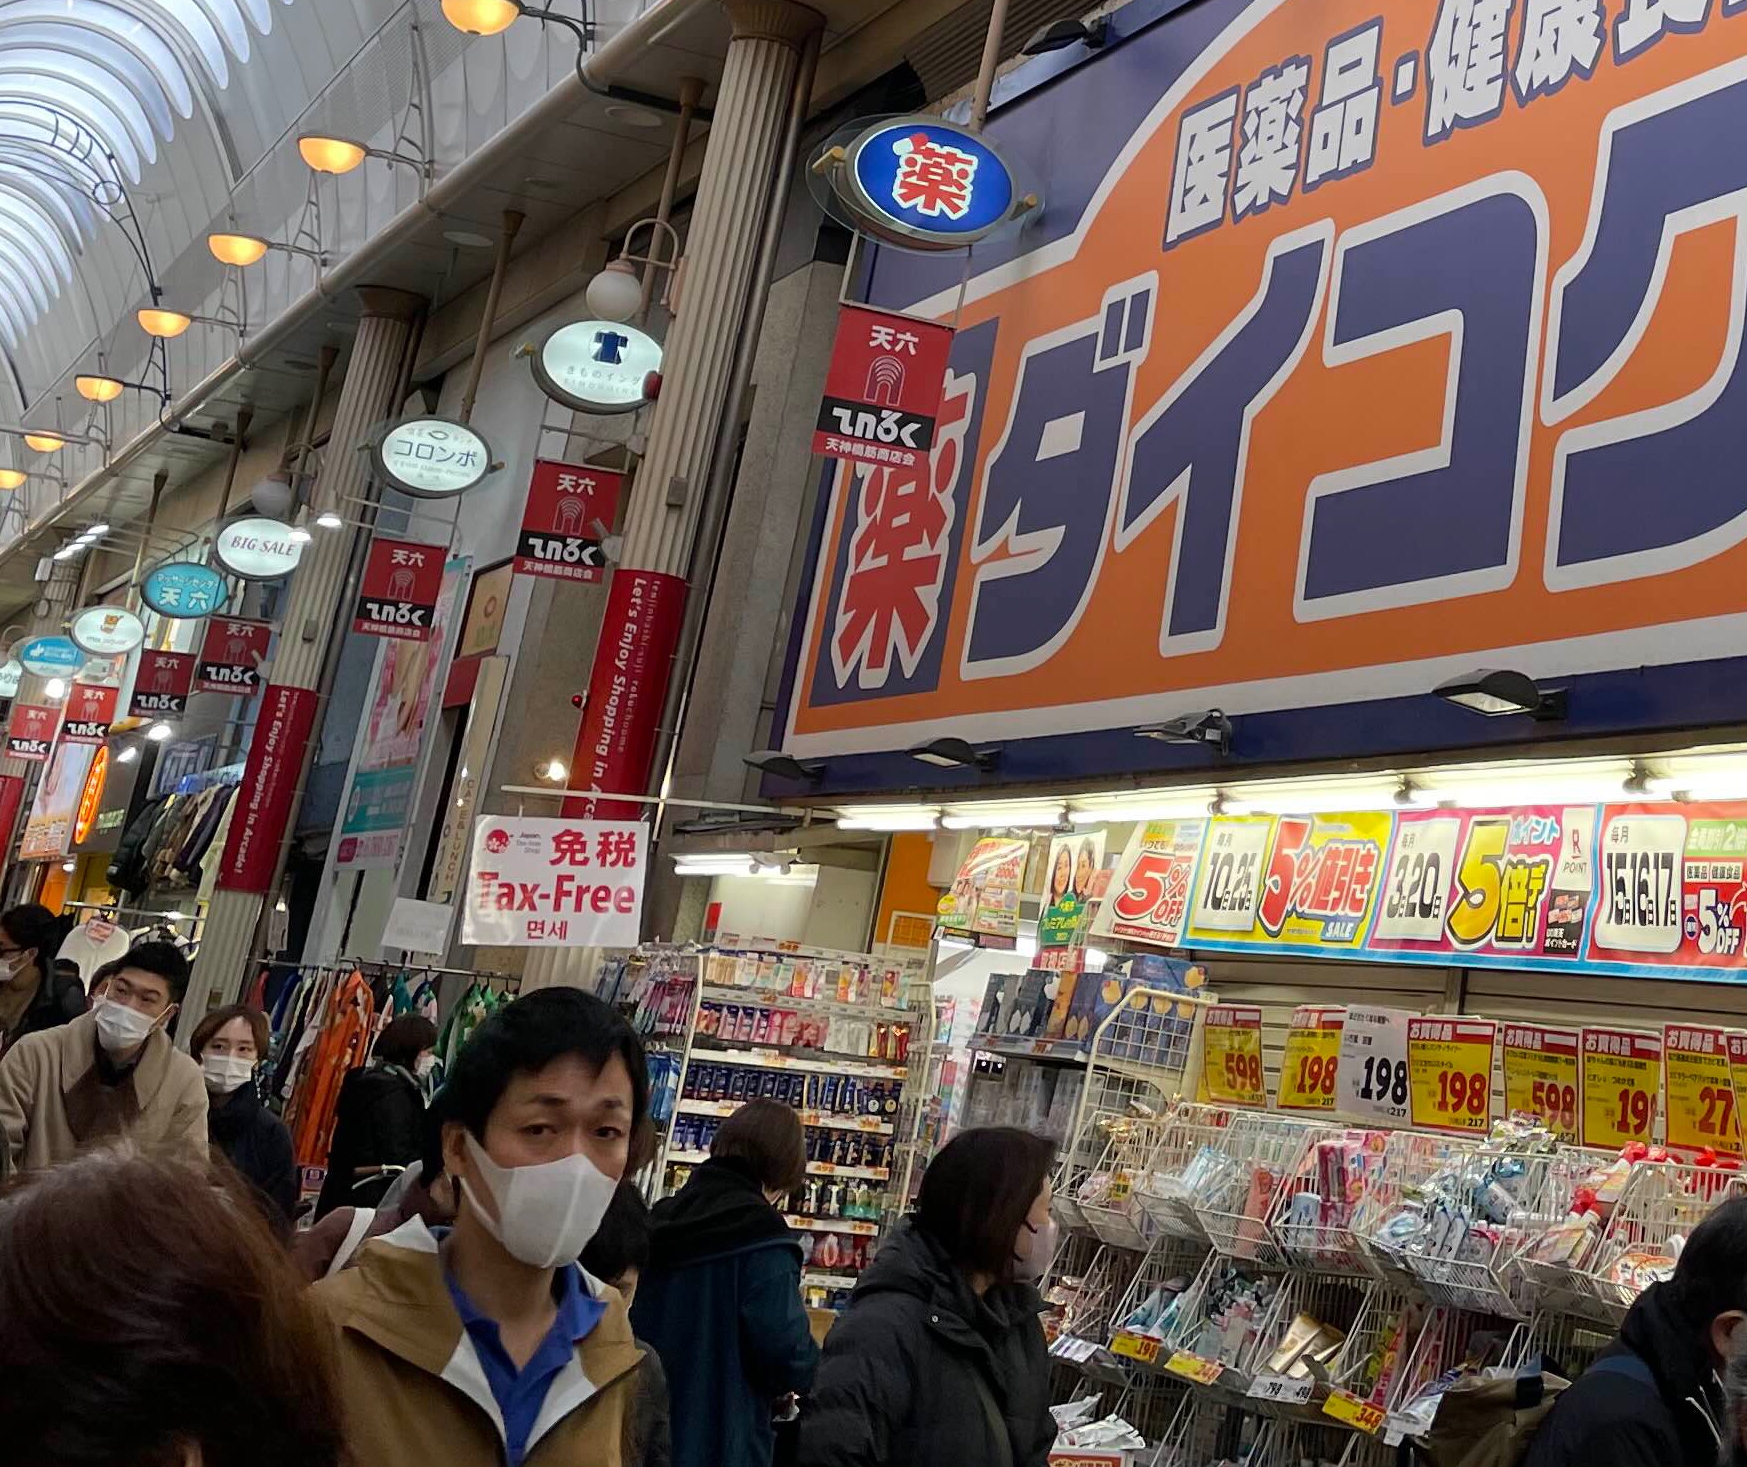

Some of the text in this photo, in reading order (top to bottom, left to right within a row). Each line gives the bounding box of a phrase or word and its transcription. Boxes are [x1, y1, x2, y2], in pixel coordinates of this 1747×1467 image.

[893, 135, 977, 220] 薬
[868, 324, 920, 356] 天六
[556, 473, 597, 496] 天六
[230, 535, 296, 557] BIG SALE
[390, 548, 427, 568] 天六
[158, 586, 211, 611] 天六
[226, 622, 256, 638] 天六
[154, 656, 180, 670] 天六
[592, 577, 648, 778] Let's Enjoy Shopping in
[82, 688, 106, 701] 天六
[1510, 815, 1560, 846] ポイント
[1611, 825, 1629, 845] 毎月
[549, 828, 637, 868] 免税
[1563, 861, 1588, 875] POINT
[476, 870, 636, 914] Tax-Free
[1151, 898, 1184, 927] OFF
[526, 918, 569, 941] 면세
[1325, 920, 1354, 938] SALE
[1716, 928, 1741, 955] OFF
[1409, 1021, 1453, 1041] お買得品
[1505, 1028, 1543, 1050] お買得品
[1667, 1029, 1715, 1052] お買得品
[1585, 1032, 1632, 1056] お買得品
[1225, 1052, 1262, 1093] 598
[1296, 1055, 1338, 1095] 198
[1361, 1056, 1408, 1105] 198
[1321, 1097, 1335, 1106] 217
[1437, 1069, 1487, 1115] 198
[1390, 1106, 1407, 1118] 217
[1532, 1080, 1576, 1131] 598
[1467, 1118, 1485, 1127] 217
[1356, 1406, 1383, 1430] 348
